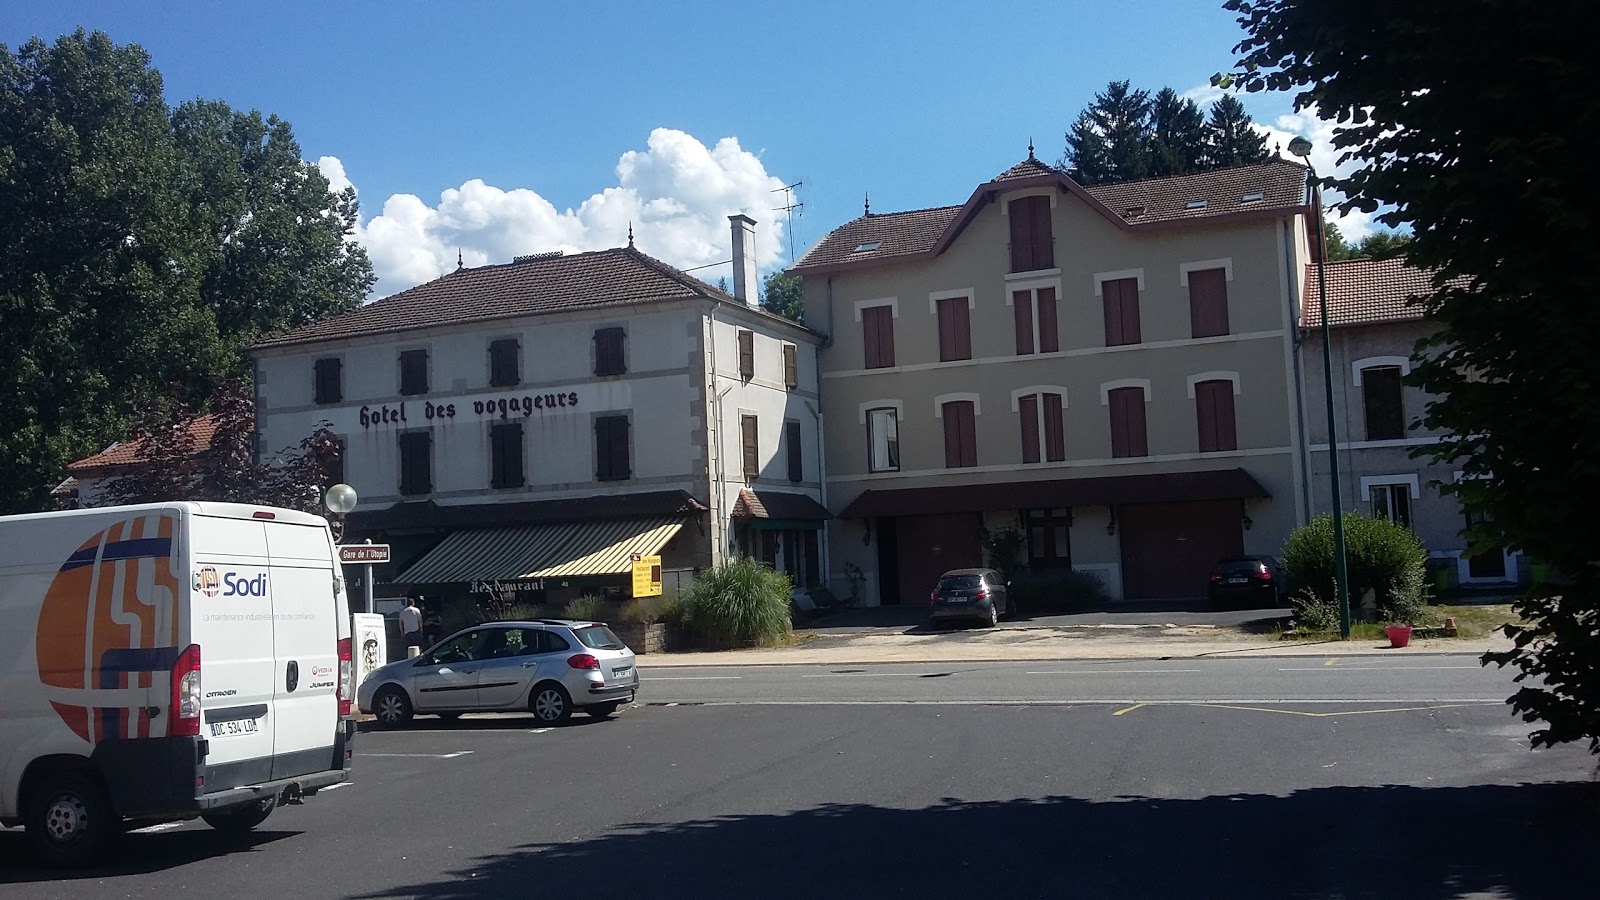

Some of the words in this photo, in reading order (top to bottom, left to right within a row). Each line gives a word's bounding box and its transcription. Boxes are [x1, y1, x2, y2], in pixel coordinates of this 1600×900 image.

[425, 401, 456, 420] des
[473, 391, 578, 419] voyageurs
[343, 550, 356, 559] Gare
[357, 550, 365, 558] de
[223, 572, 267, 597] Sodi
[210, 613, 244, 621] maintenance
[309, 681, 335, 689] JUMPER
[227, 721, 242, 734] 534
